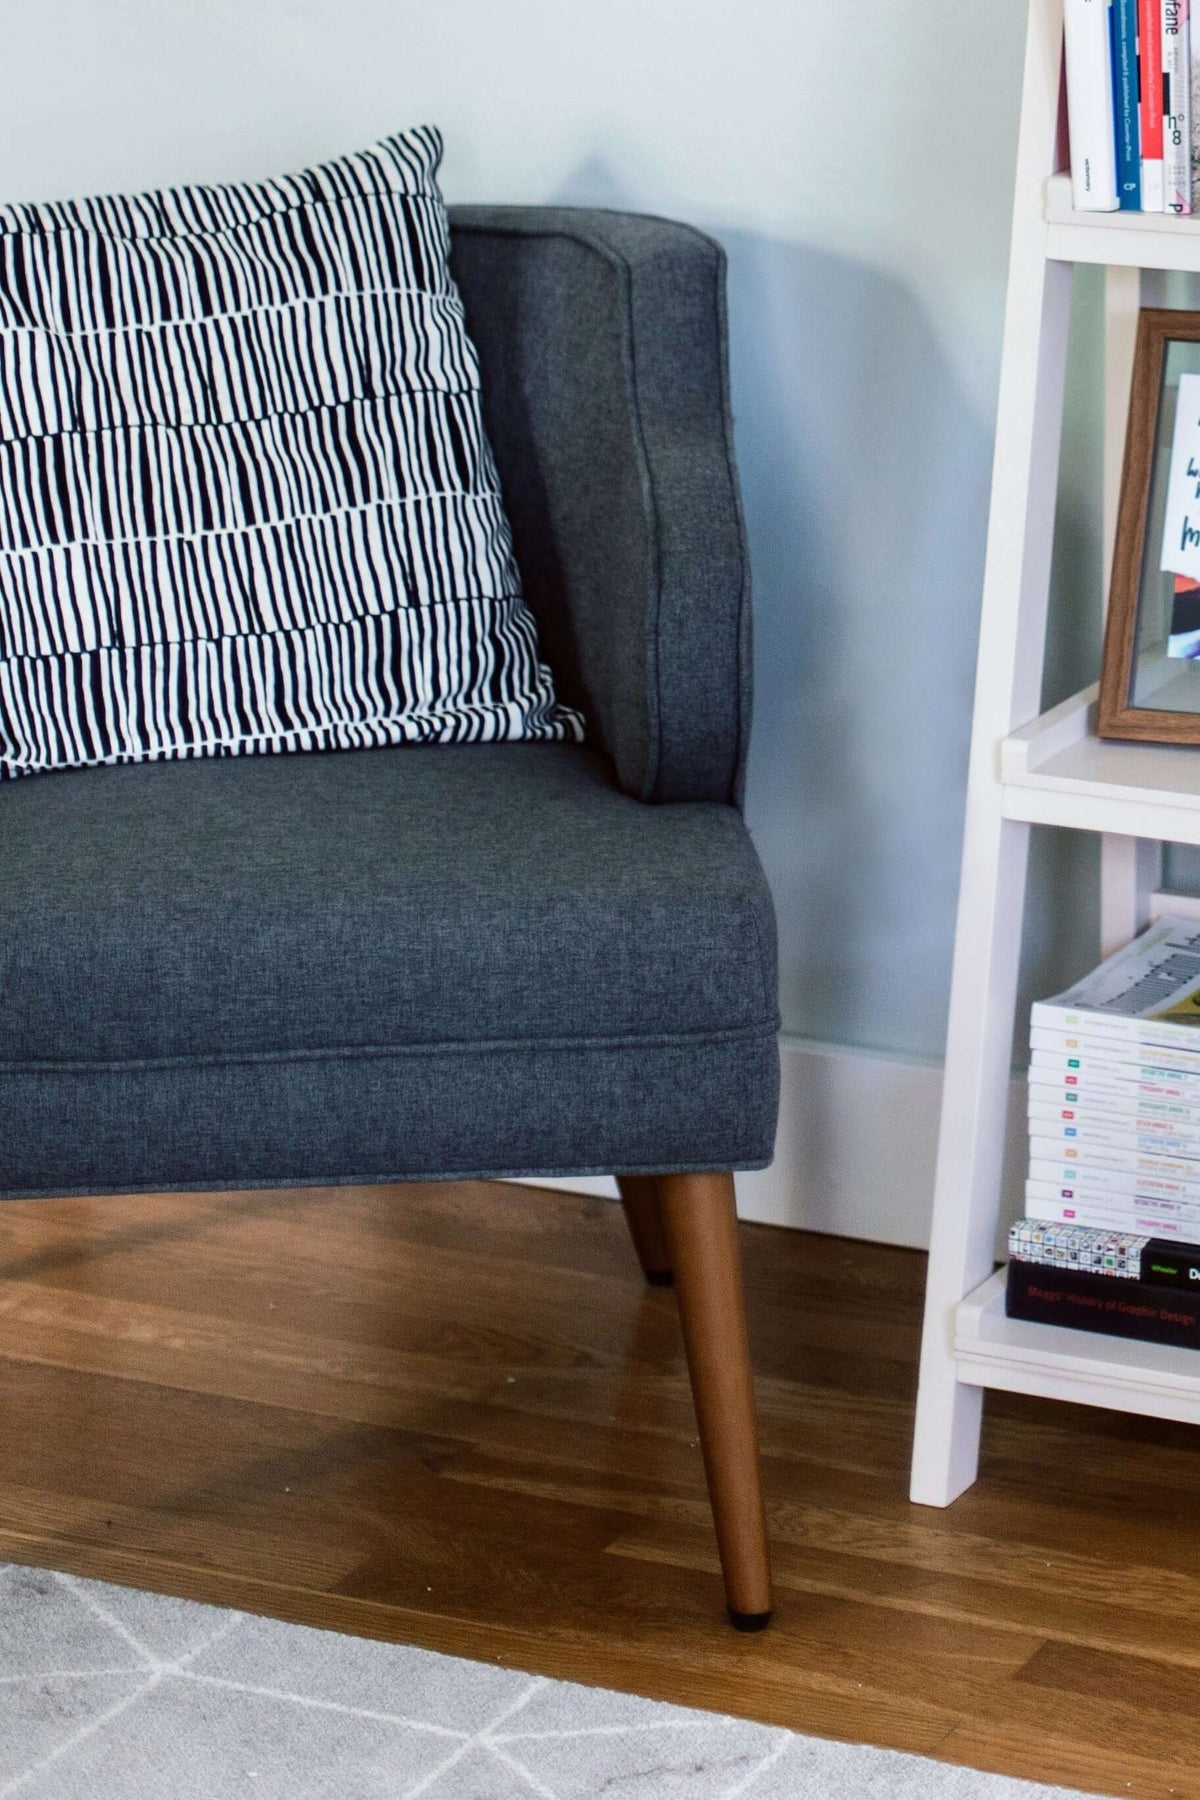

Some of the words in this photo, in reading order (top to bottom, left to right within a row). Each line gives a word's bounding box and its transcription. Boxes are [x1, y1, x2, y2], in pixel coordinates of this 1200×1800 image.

[1066, 1294, 1102, 1310] History
[1105, 1300, 1117, 1311] of
[1118, 1302, 1157, 1318] Graphic
[1160, 1310, 1196, 1326] Design
